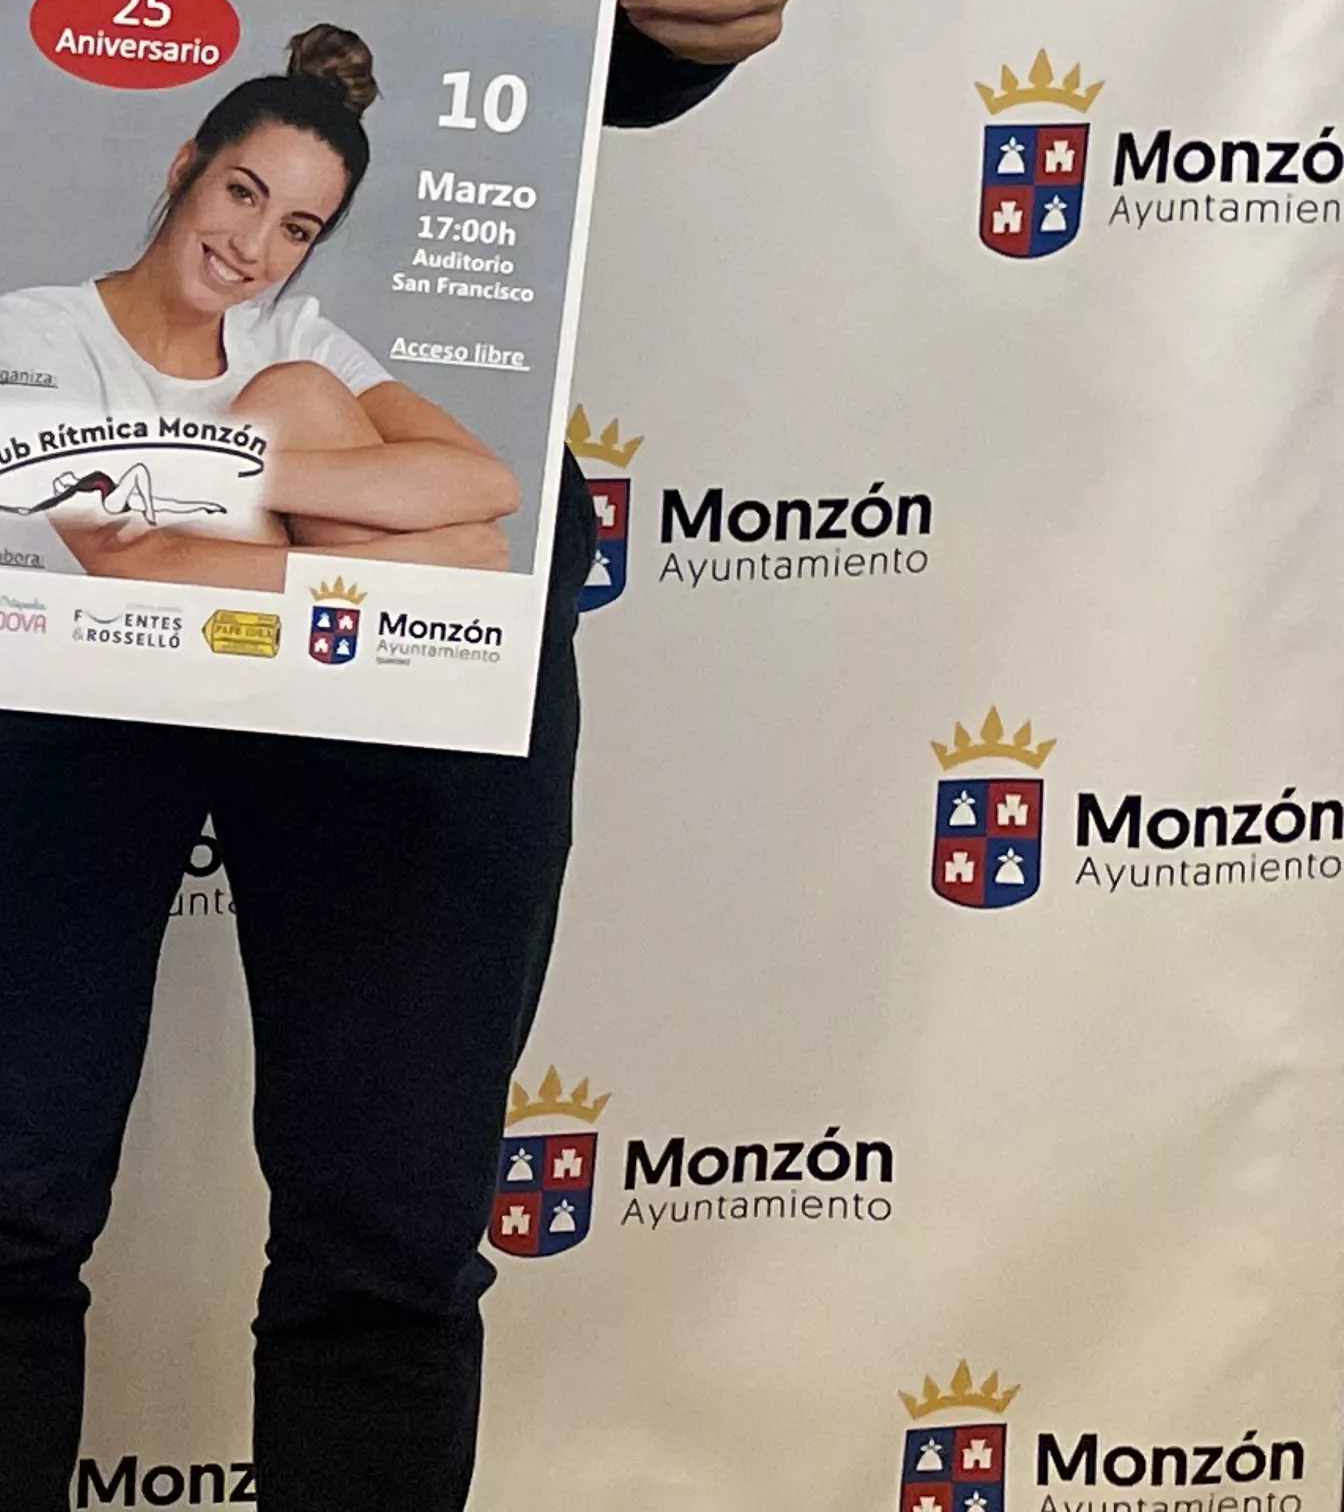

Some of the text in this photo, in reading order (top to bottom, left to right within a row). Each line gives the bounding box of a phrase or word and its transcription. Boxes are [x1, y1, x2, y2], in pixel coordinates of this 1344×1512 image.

[55, 27, 220, 66] Aniversario
[438, 71, 528, 133] 10
[1113, 126, 1344, 186] Monzó
[417, 170, 538, 210] Marzo
[417, 216, 517, 246] 17:00h
[1109, 192, 1342, 230] Ayuntamien
[412, 248, 515, 275] Auditorio
[392, 273, 534, 303] San Francisco
[391, 338, 525, 368] Acceso libre
[39, 416, 149, 452] Rítmica
[158, 417, 268, 456] Monzón
[661, 482, 932, 544] Monzón
[659, 546, 929, 588] Ayuntamiento
[378, 611, 503, 646] Monzón
[376, 639, 500, 663] Ayuntamiento
[1076, 787, 1344, 850] Monzón
[1076, 852, 1342, 893] Ayuntamiento
[624, 1126, 894, 1190] Monzón
[621, 1189, 893, 1230] Ayuntamiento
[1036, 1430, 1304, 1487] Monzón
[76, 1455, 256, 1509] Monz
